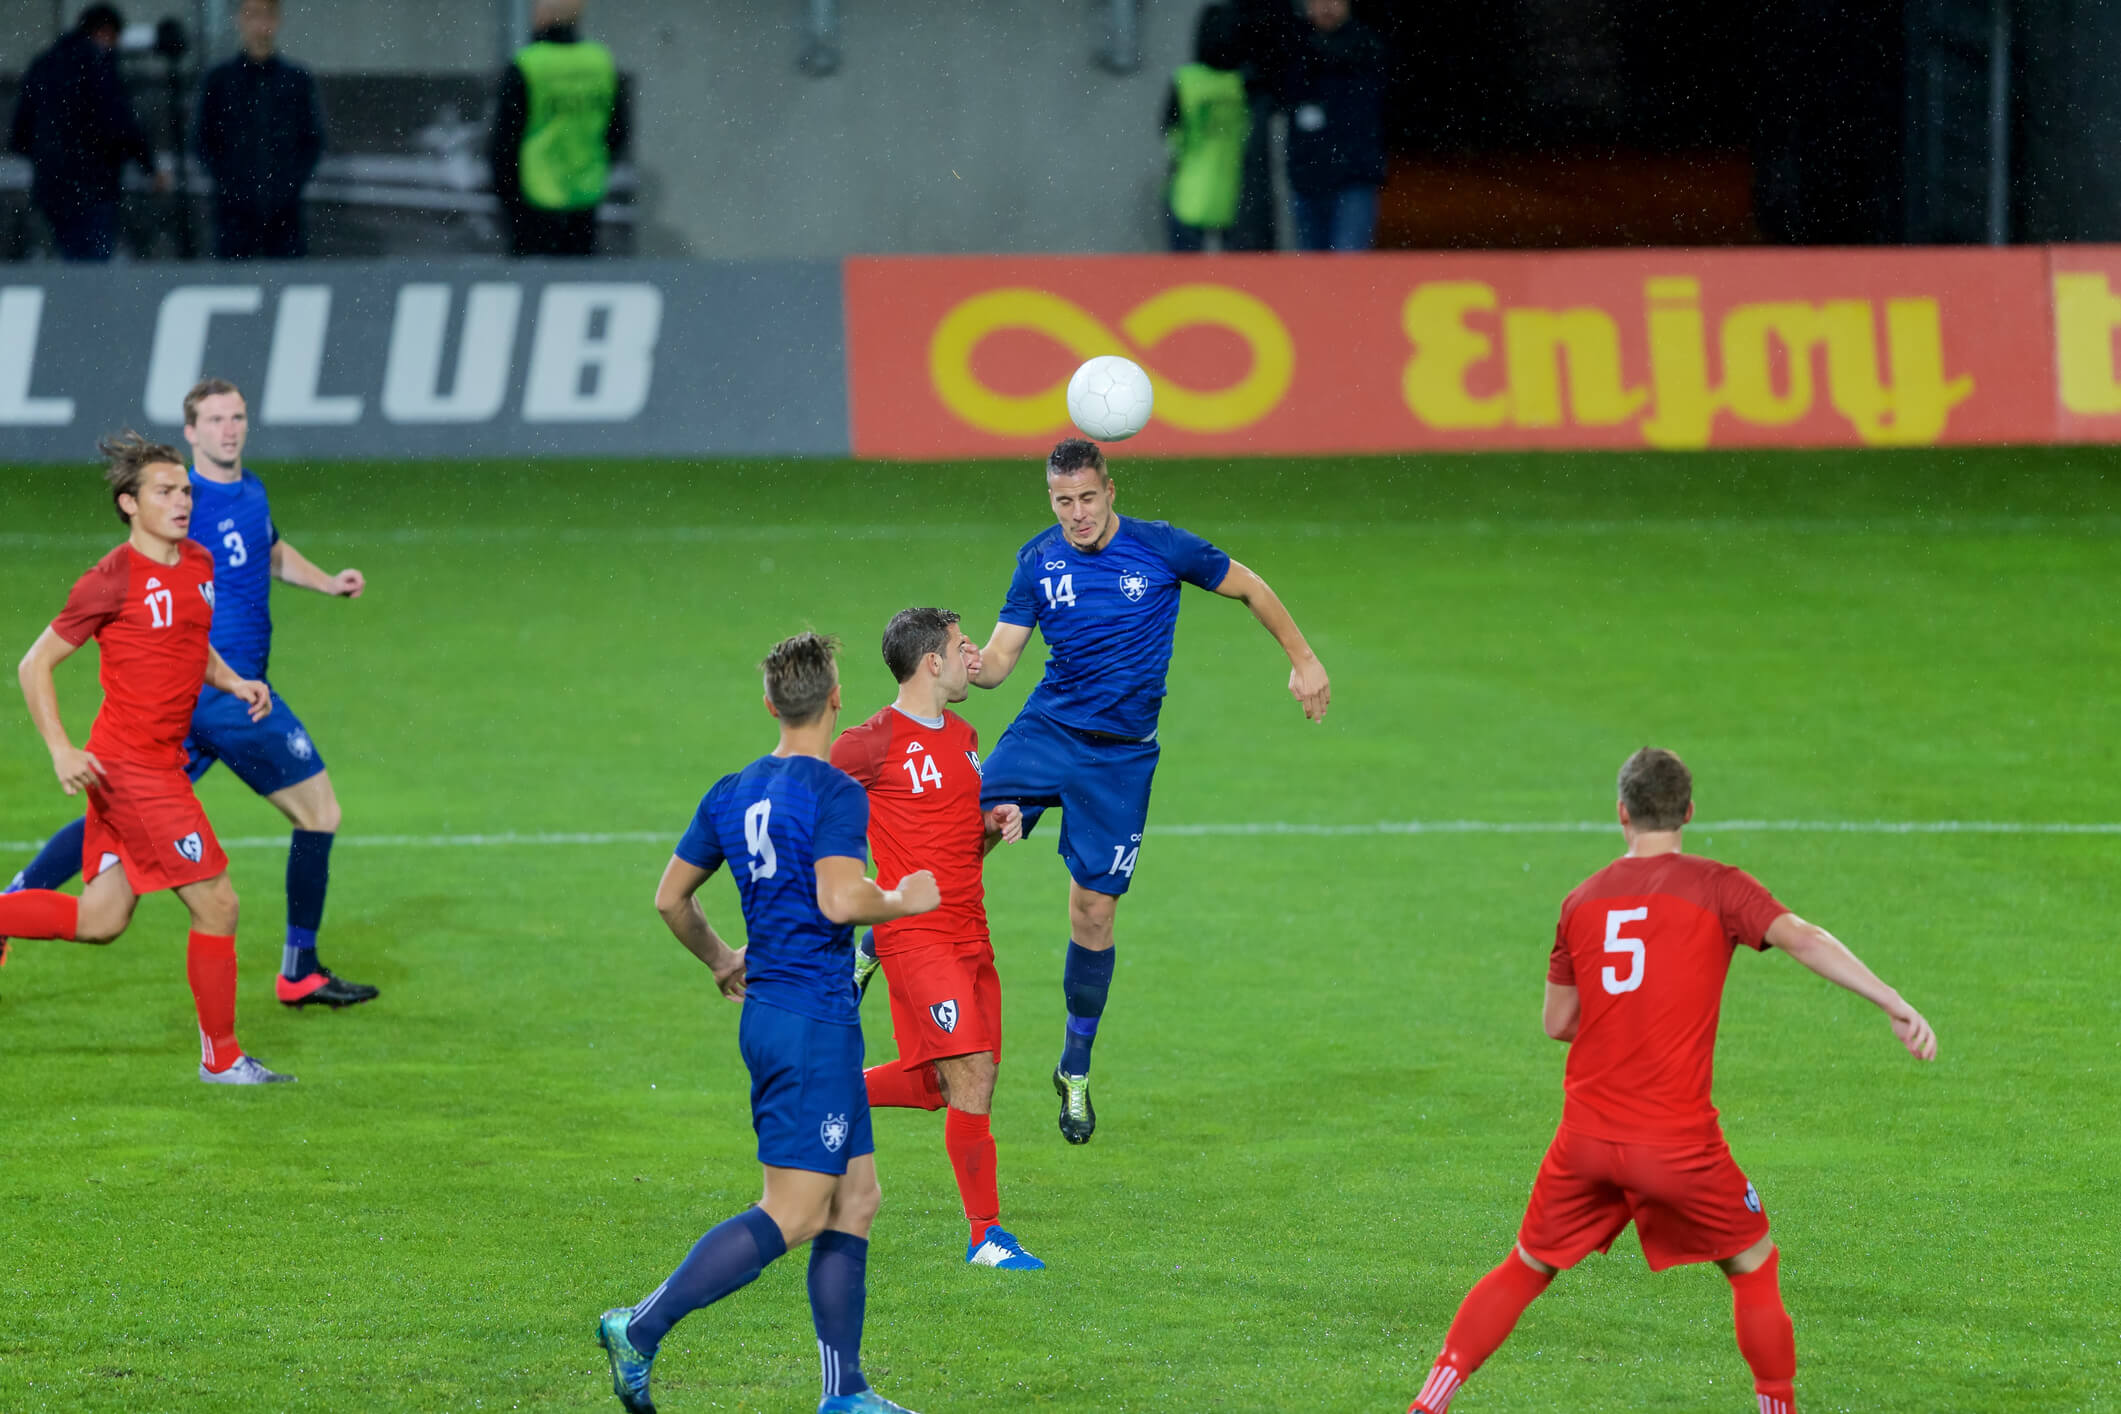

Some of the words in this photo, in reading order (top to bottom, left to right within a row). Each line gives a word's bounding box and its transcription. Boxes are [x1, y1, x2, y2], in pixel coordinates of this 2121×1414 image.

[143, 282, 664, 425] CLUB
[1402, 275, 1975, 449] Enjoy
[223, 531, 247, 567] 3
[144, 589, 173, 628] 17
[1040, 573, 1076, 610] 14
[903, 754, 943, 794] 14
[744, 798, 777, 883] 9
[1108, 845, 1139, 878] 14
[1602, 906, 1648, 995] 5
